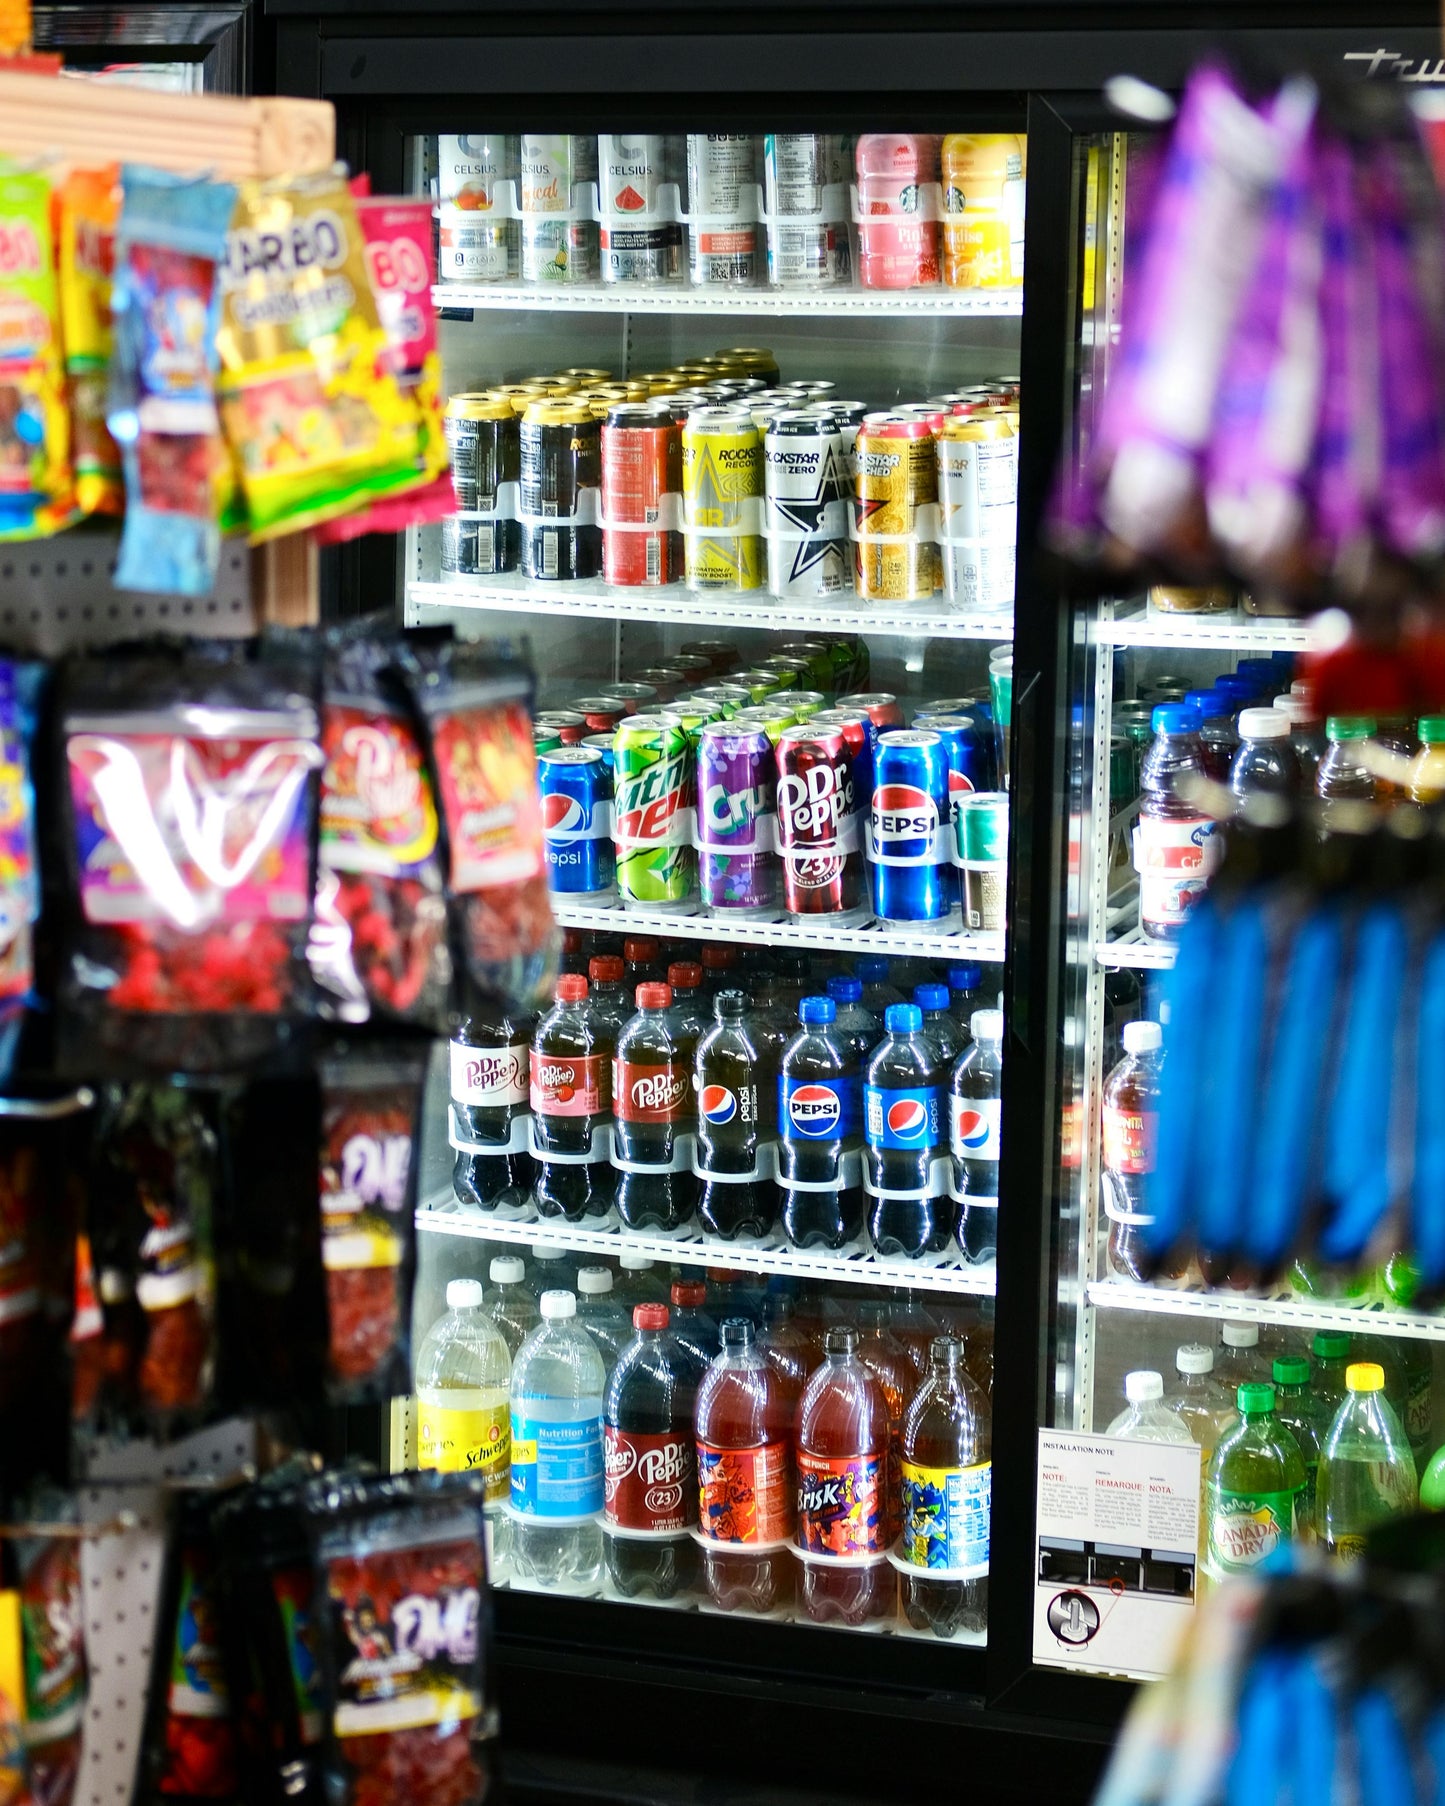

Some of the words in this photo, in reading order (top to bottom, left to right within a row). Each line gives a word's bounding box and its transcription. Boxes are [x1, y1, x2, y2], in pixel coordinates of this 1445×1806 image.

[1344, 48, 1445, 82] Tru
[454, 164, 497, 175] CELSIUS
[609, 166, 653, 176] CELSIUS
[718, 448, 757, 461] ROCKS
[788, 466, 816, 474] ZERO
[805, 763, 847, 804] Dr
[776, 774, 855, 837] Peppe
[871, 815, 936, 834] PEPSI
[800, 857, 826, 877] 23
[1181, 855, 1203, 869] Cra
[479, 1057, 502, 1074] Dr
[465, 1061, 515, 1090] Pepper
[539, 1066, 572, 1087] Pepper
[652, 1073, 675, 1093] Dr
[631, 1077, 687, 1109] Pepper
[737, 1086, 752, 1122] pepsi
[791, 1102, 838, 1115] PEPSI
[928, 1097, 940, 1134] pepsi
[539, 1428, 583, 1438] Nutrition
[464, 1430, 511, 1470] Schweppe
[512, 1446, 530, 1460] ppes
[664, 1443, 686, 1465] Dr
[1043, 1441, 1094, 1454] INSTALLATION
[1094, 1448, 1115, 1457] NOTE
[605, 1450, 632, 1473] pper
[811, 1458, 830, 1470] PUNCH
[494, 1469, 510, 1481] WAT
[1042, 1472, 1067, 1483] NOTE:
[1095, 1478, 1145, 1493] REMARQUE:
[1149, 1484, 1175, 1496] NOTA:
[656, 1492, 671, 1506] 23
[1231, 1537, 1265, 1558] DRY
